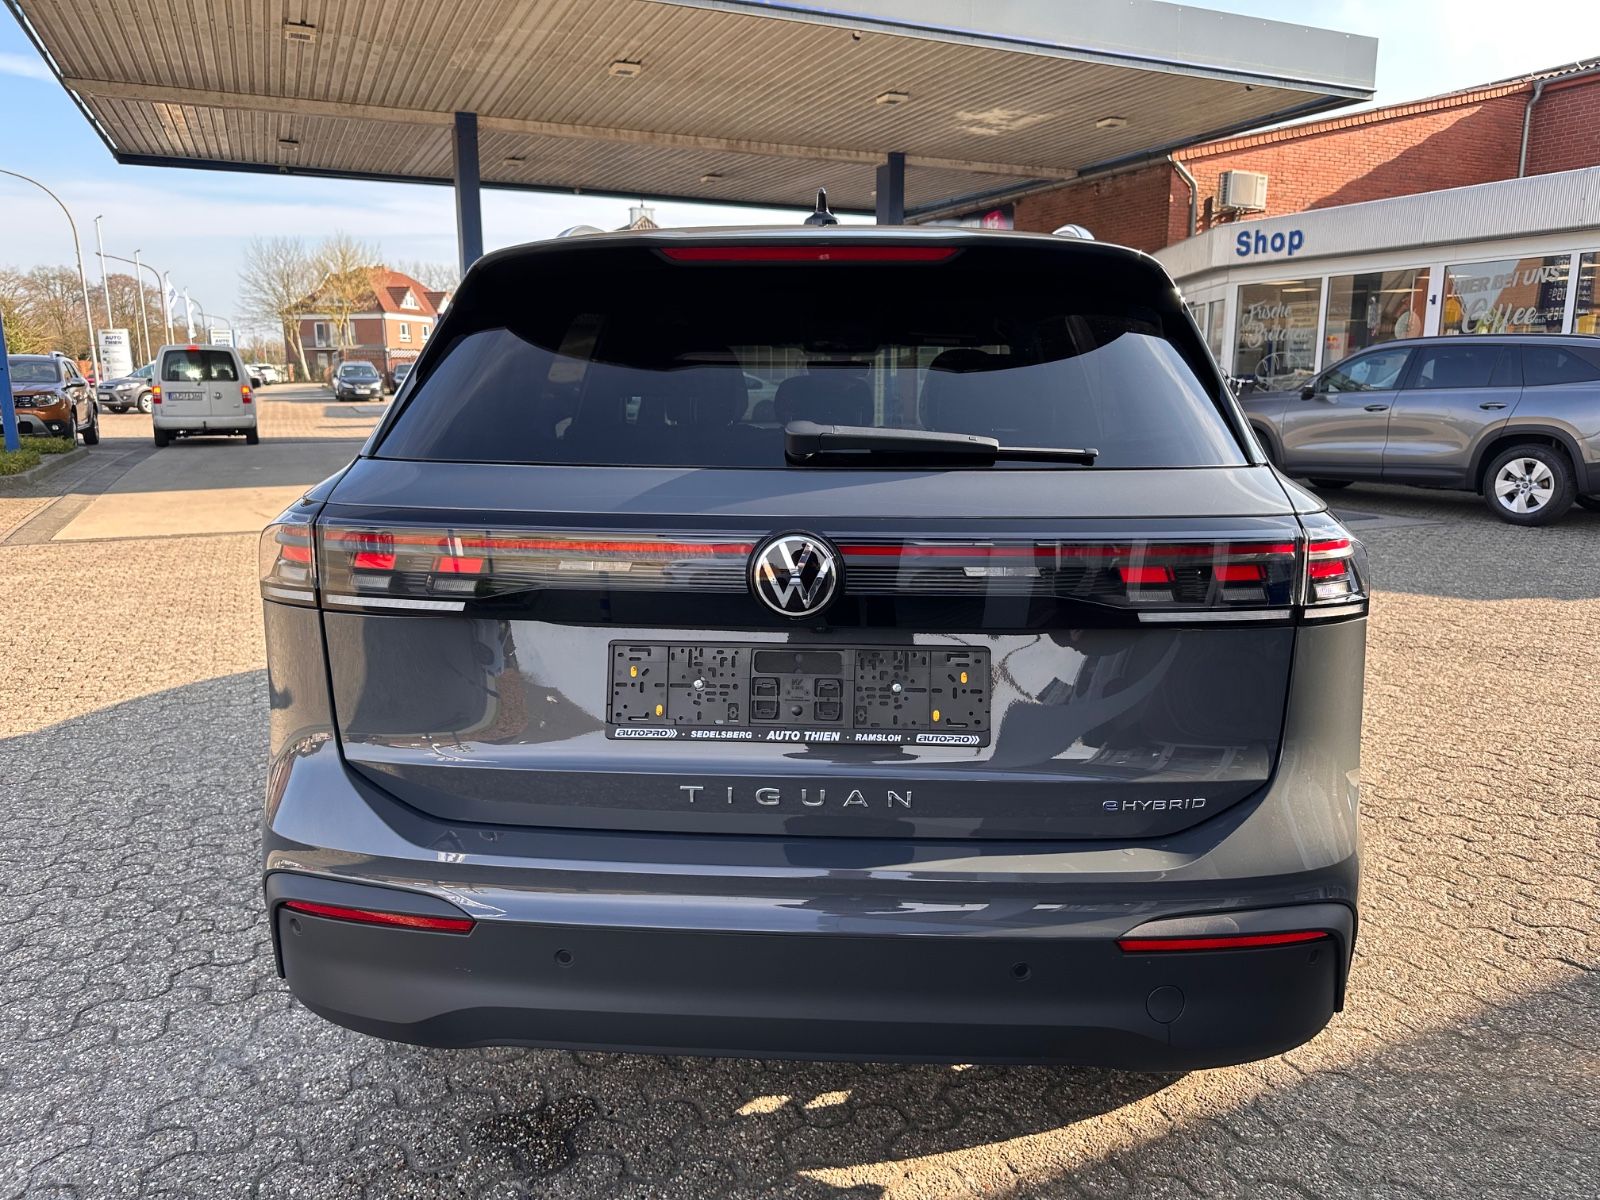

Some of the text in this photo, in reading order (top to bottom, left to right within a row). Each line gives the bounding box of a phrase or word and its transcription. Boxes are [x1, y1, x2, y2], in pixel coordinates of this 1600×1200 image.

[1236, 229, 1303, 256] Shop
[1523, 266, 1560, 286] UNS
[1462, 298, 1538, 334] Coffee
[690, 730, 902, 742] SEDELSBERG AUTO THIEN RAMSLOH
[680, 785, 912, 808] TIGUAN
